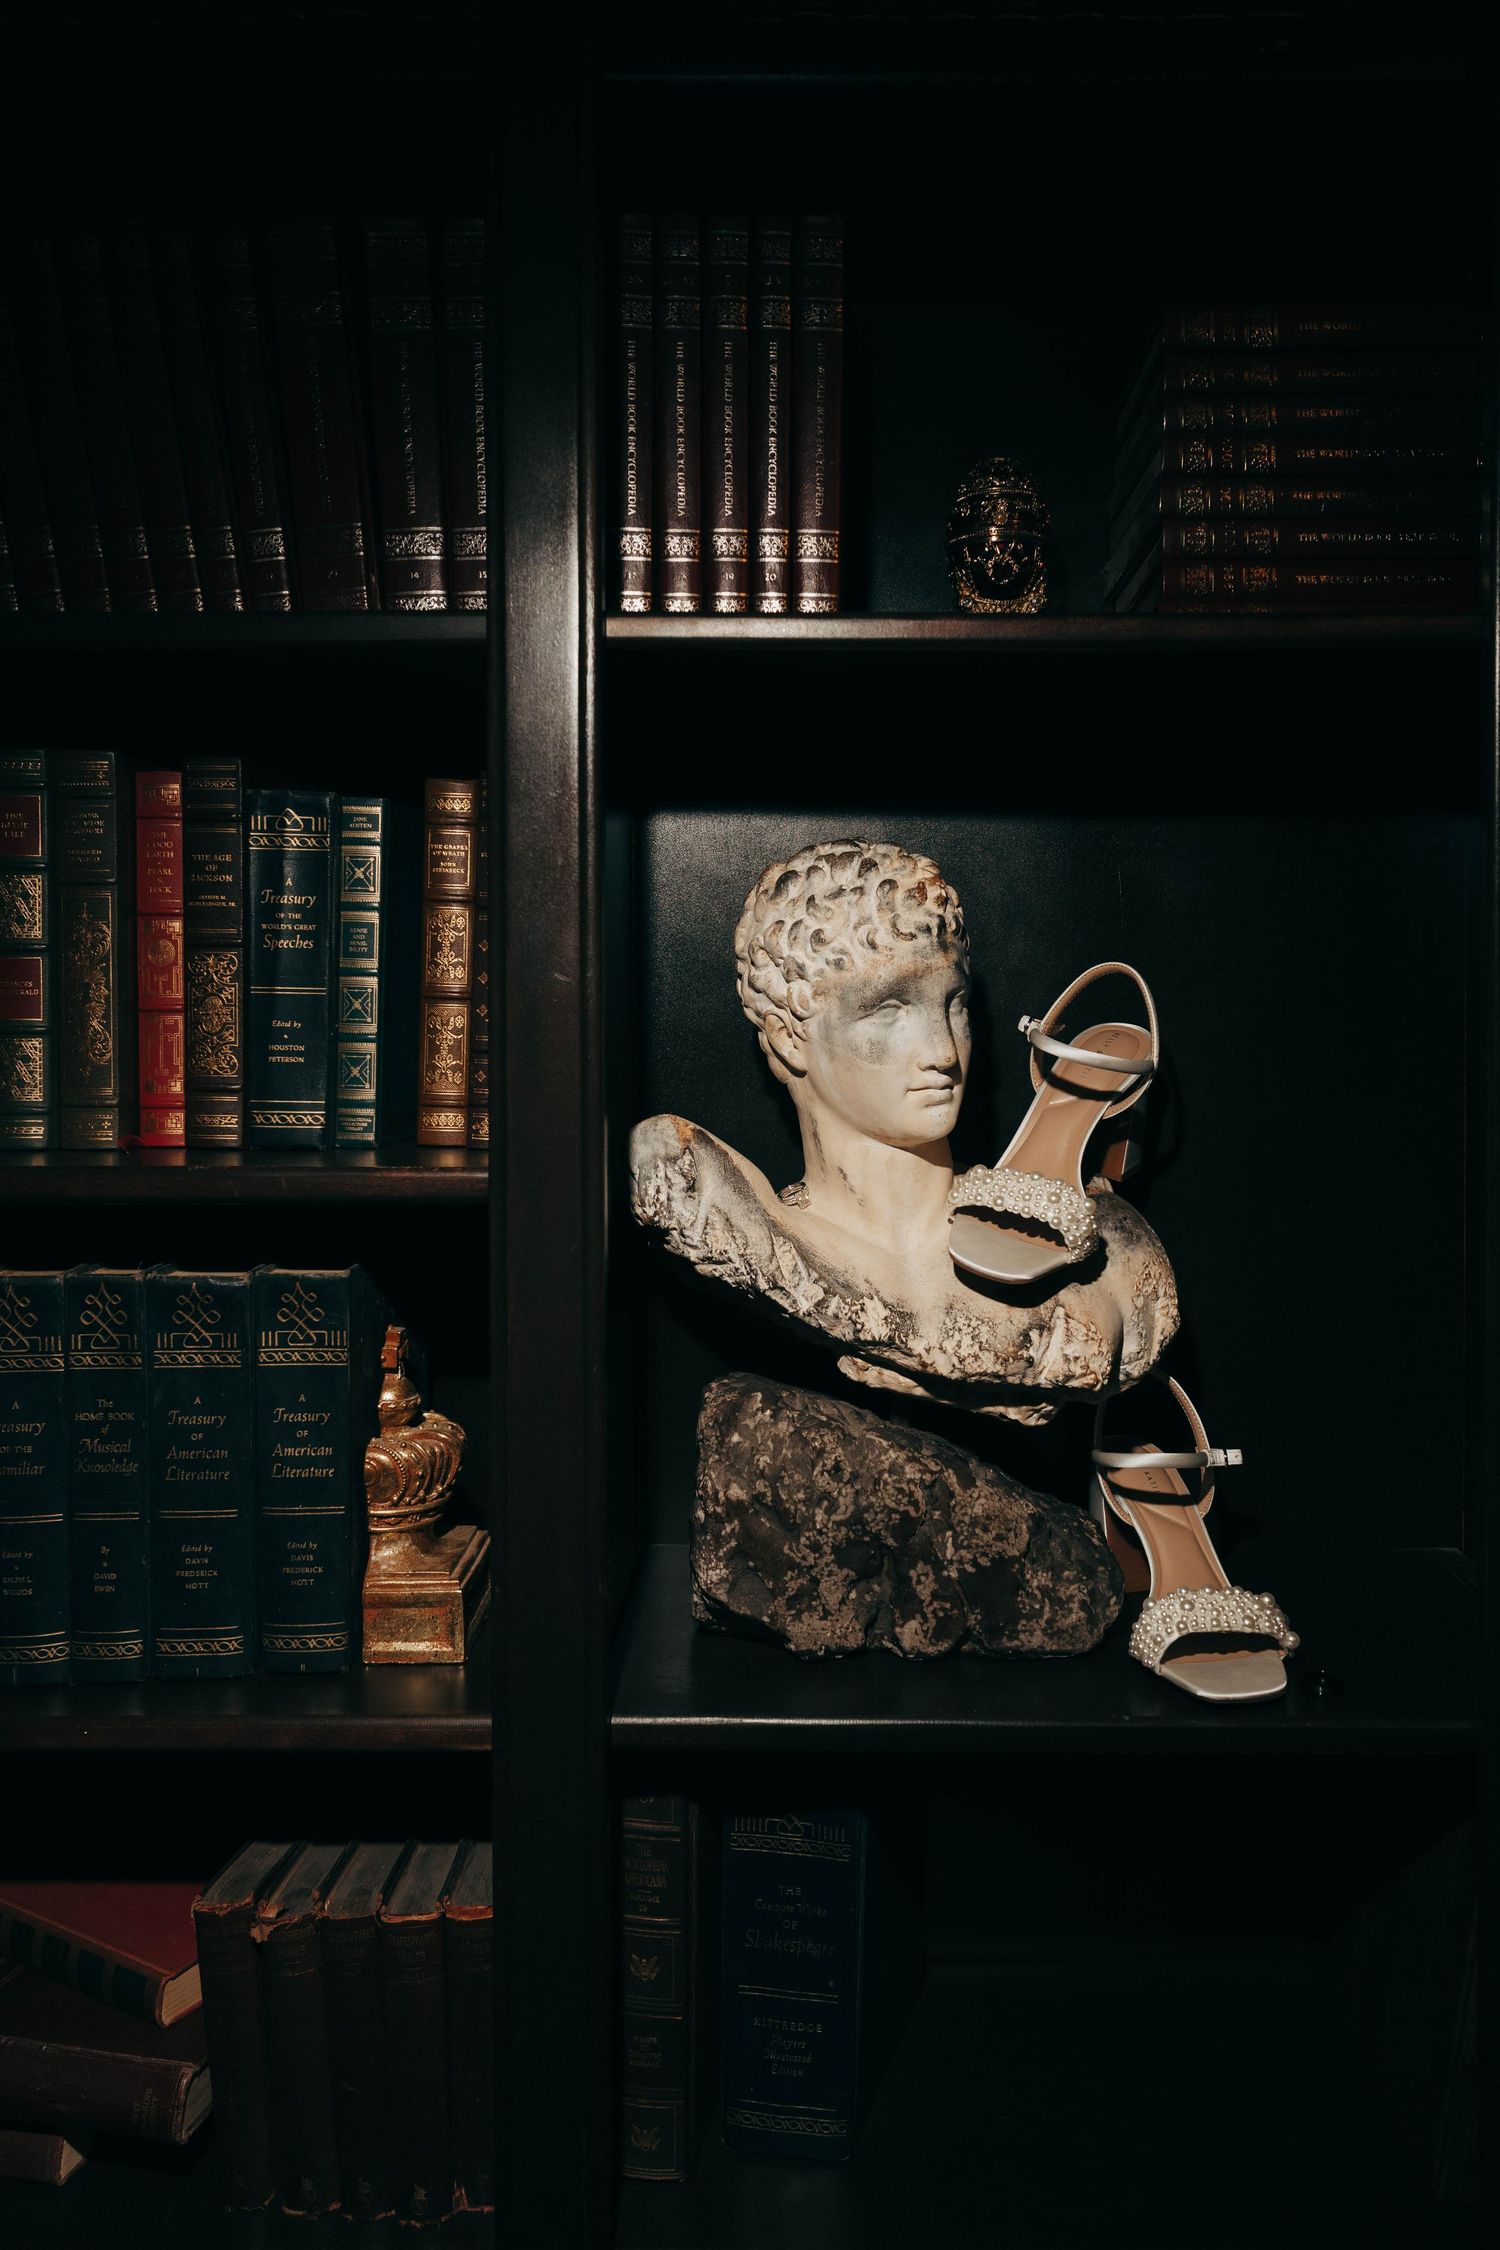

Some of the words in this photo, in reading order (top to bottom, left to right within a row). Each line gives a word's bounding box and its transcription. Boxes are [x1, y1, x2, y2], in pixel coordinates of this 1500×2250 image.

[475, 341, 483, 360] THE
[628, 339, 636, 357] THE
[677, 341, 685, 359] THE
[724, 341, 733, 359] THE
[769, 341, 778, 359] THE
[475, 363, 484, 401] WORLD
[628, 362, 636, 400] WORLD
[677, 364, 685, 402] WORLD
[724, 364, 733, 402] WORLD
[769, 364, 778, 402] WORLD
[476, 404, 485, 434] BOOK
[628, 404, 636, 434] BOOK
[677, 406, 685, 435] BOOK
[724, 406, 733, 435] BOOK
[769, 406, 778, 435] BOOK
[405, 437, 416, 515] ENCYCLOPEDIA
[477, 436, 487, 516] ENCYCLOPEDIA
[627, 436, 637, 517] ENCYCLOPEDIA
[677, 438, 686, 517] ENCYCLOPEDIA
[724, 438, 733, 517] ENCYCLOPEDIA
[767, 438, 777, 517] ENCYCLOPEDIA
[765, 572, 777, 581] 20
[192, 854, 211, 862] THE
[213, 854, 233, 862] AGE
[147, 868, 174, 876] PEARL
[190, 874, 233, 882] JACKSON
[285, 877, 293, 886] A
[260, 889, 317, 909] Treasury
[261, 923, 293, 931] WORLD'S
[263, 933, 315, 951] Speeches
[272, 1019, 291, 1028] Edited
[293, 1020, 302, 1030] by
[268, 1044, 305, 1052] HOUSTON
[11, 1400, 21, 1410] A
[96, 1398, 113, 1408] The
[193, 1396, 202, 1405] A
[298, 1393, 307, 1403] A
[75, 1412, 103, 1421] HOME
[107, 1412, 135, 1421] BOOK
[167, 1410, 226, 1429] Treasury
[272, 1407, 331, 1426] Treasury
[0, 1422, 46, 1436] easury
[100, 1424, 110, 1436] of
[296, 1429, 310, 1438] OF
[191, 1433, 204, 1441] OF
[14, 1445, 33, 1454] THE
[78, 1438, 131, 1454] Musical
[166, 1445, 229, 1460] American
[272, 1443, 333, 1457] American
[0, 1461, 46, 1476] amiliar
[73, 1457, 139, 1476] Knowledge
[164, 1465, 230, 1481] Literature
[272, 1463, 335, 1479] Literature
[100, 1546, 110, 1556] By
[180, 1544, 202, 1553] Edited
[204, 1545, 214, 1554] by
[286, 1542, 307, 1551] Edited
[309, 1542, 319, 1551] by
[185, 1557, 209, 1566] DAVIS
[290, 1554, 315, 1562] DAVIS
[93, 1572, 117, 1580] DAVID
[176, 1569, 219, 1578] FREDERICK
[282, 1566, 324, 1575] FREDERICK
[184, 1582, 210, 1590] MOTT
[290, 1578, 316, 1587] MOTT
[782, 1919, 801, 1930] OF
[743, 1928, 838, 1958] Shakespeare
[753, 2016, 825, 2034] KITTREDGE
[770, 2063, 805, 2079] Edition
